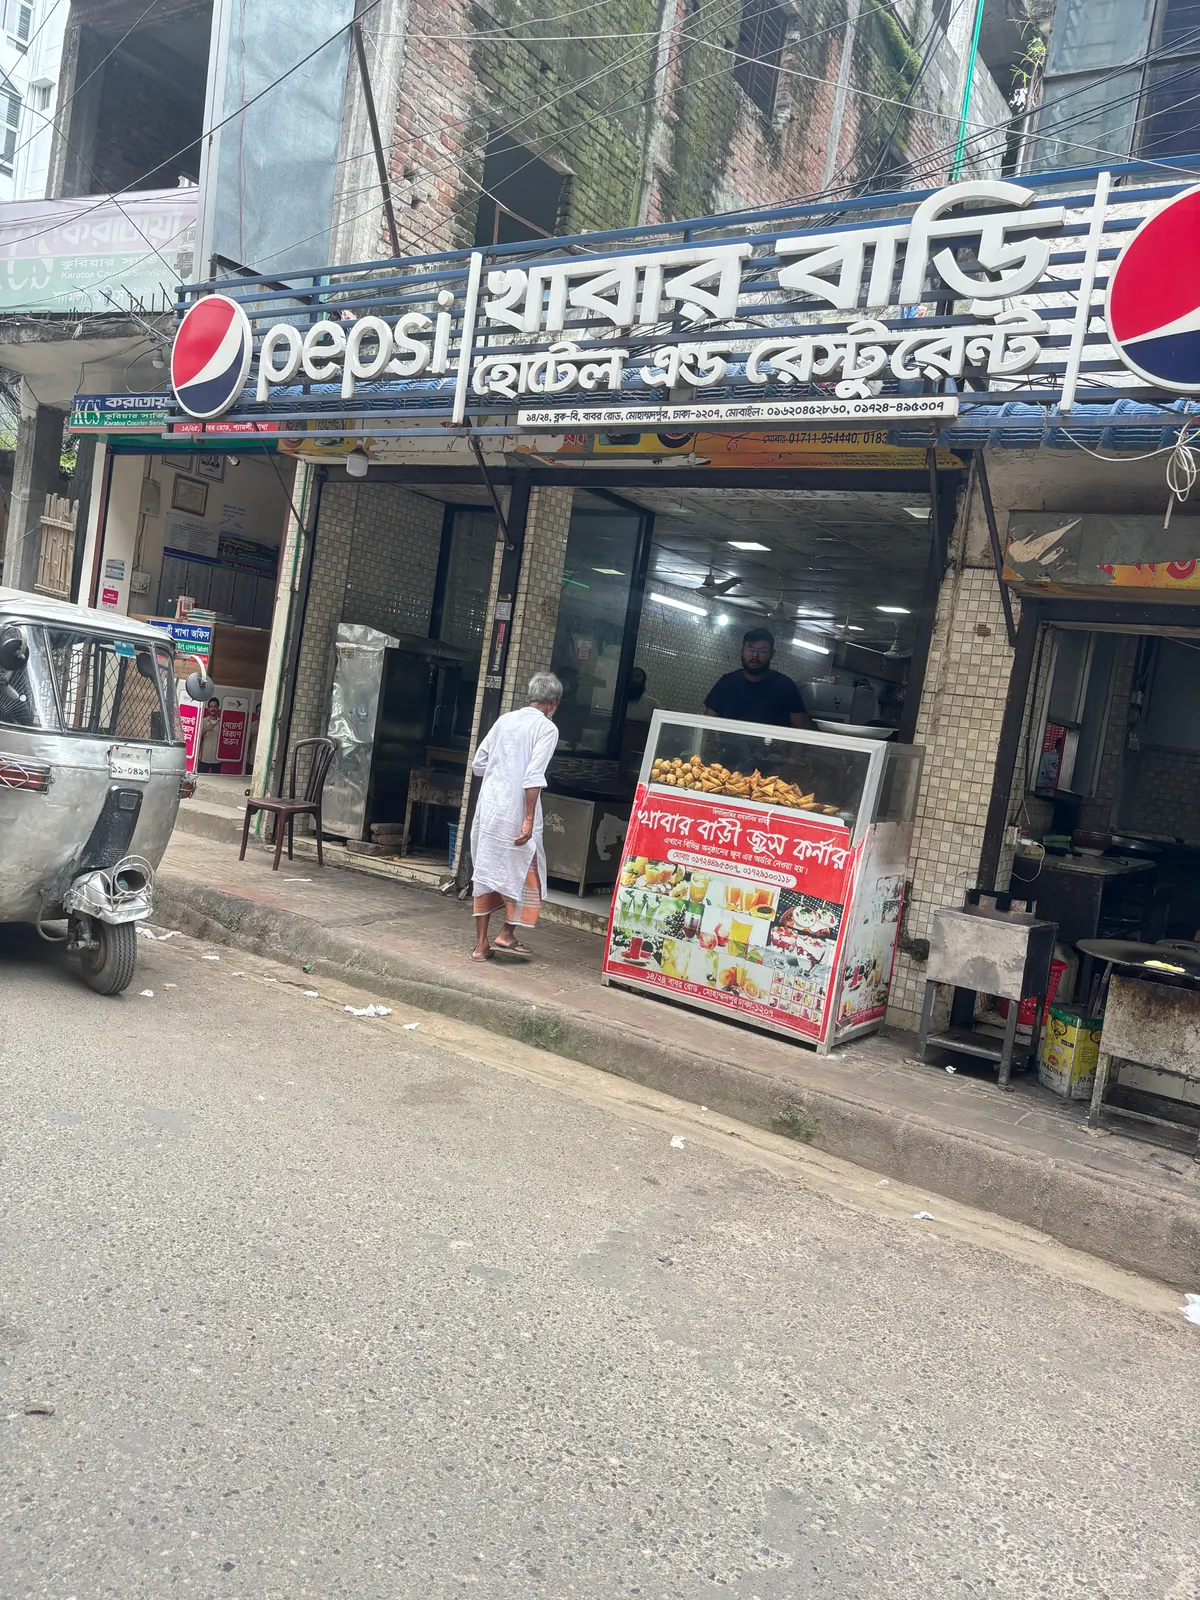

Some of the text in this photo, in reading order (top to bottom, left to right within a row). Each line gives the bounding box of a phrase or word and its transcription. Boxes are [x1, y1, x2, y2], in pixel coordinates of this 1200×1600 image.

[484, 180, 1066, 333] খাবার বাড়ি
[61, 271, 95, 280] Karatoa
[132, 268, 168, 278] Service
[256, 290, 455, 402] pepsi
[473, 341, 629, 399] হোটেল
[73, 399, 102, 425] KCS
[526, 413, 552, 422] ১৪/২৪,
[553, 410, 581, 423] ব্লক-বি,
[583, 412, 602, 421] বাবর
[603, 411, 623, 421] রোড,
[625, 409, 670, 422] মোহাম্মদপুর,
[672, 408, 723, 420] ঢাকা-১২০৭,
[767, 404, 850, 416] ০১৬২০৪৫২৮৬০,
[853, 401, 944, 413] ০১৭২৪-৪৯৫৩০৭
[174, 627, 190, 638] শাখা
[191, 628, 210, 640] অফিস
[637, 809, 850, 870] খাবার বাড়ী জুস কর্নার
[664, 838, 682, 848] এখানে
[683, 839, 700, 851] বিভিন্ন
[742, 853, 753, 862] এর
